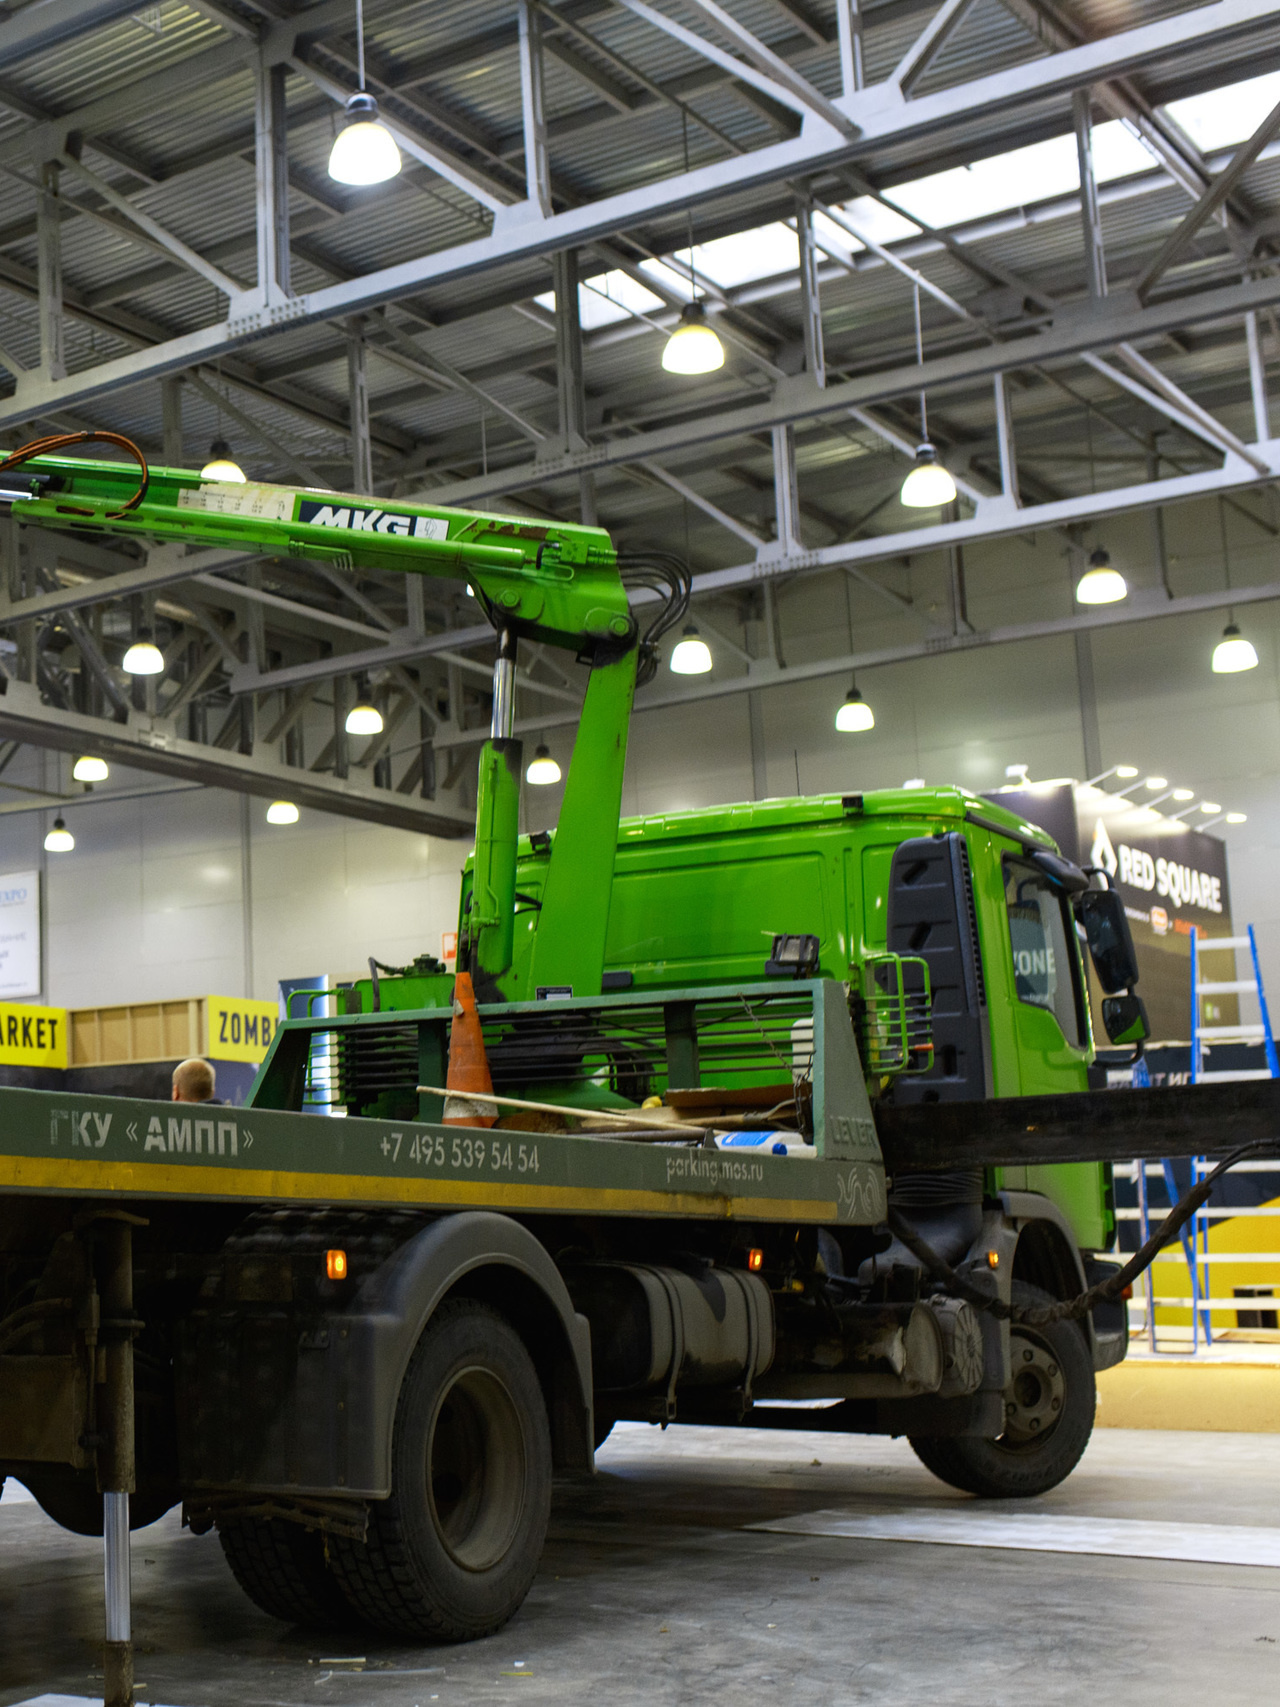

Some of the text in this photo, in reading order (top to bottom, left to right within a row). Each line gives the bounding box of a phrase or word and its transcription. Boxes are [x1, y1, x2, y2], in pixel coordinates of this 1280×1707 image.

[309, 506, 411, 538] MKG
[1119, 844, 1223, 914] RED SQUARE
[50, 1109, 113, 1148] ГКУ
[380, 1133, 540, 1173] +7 495 539 54 54
[666, 1148, 763, 1186] parking.mos.ru
